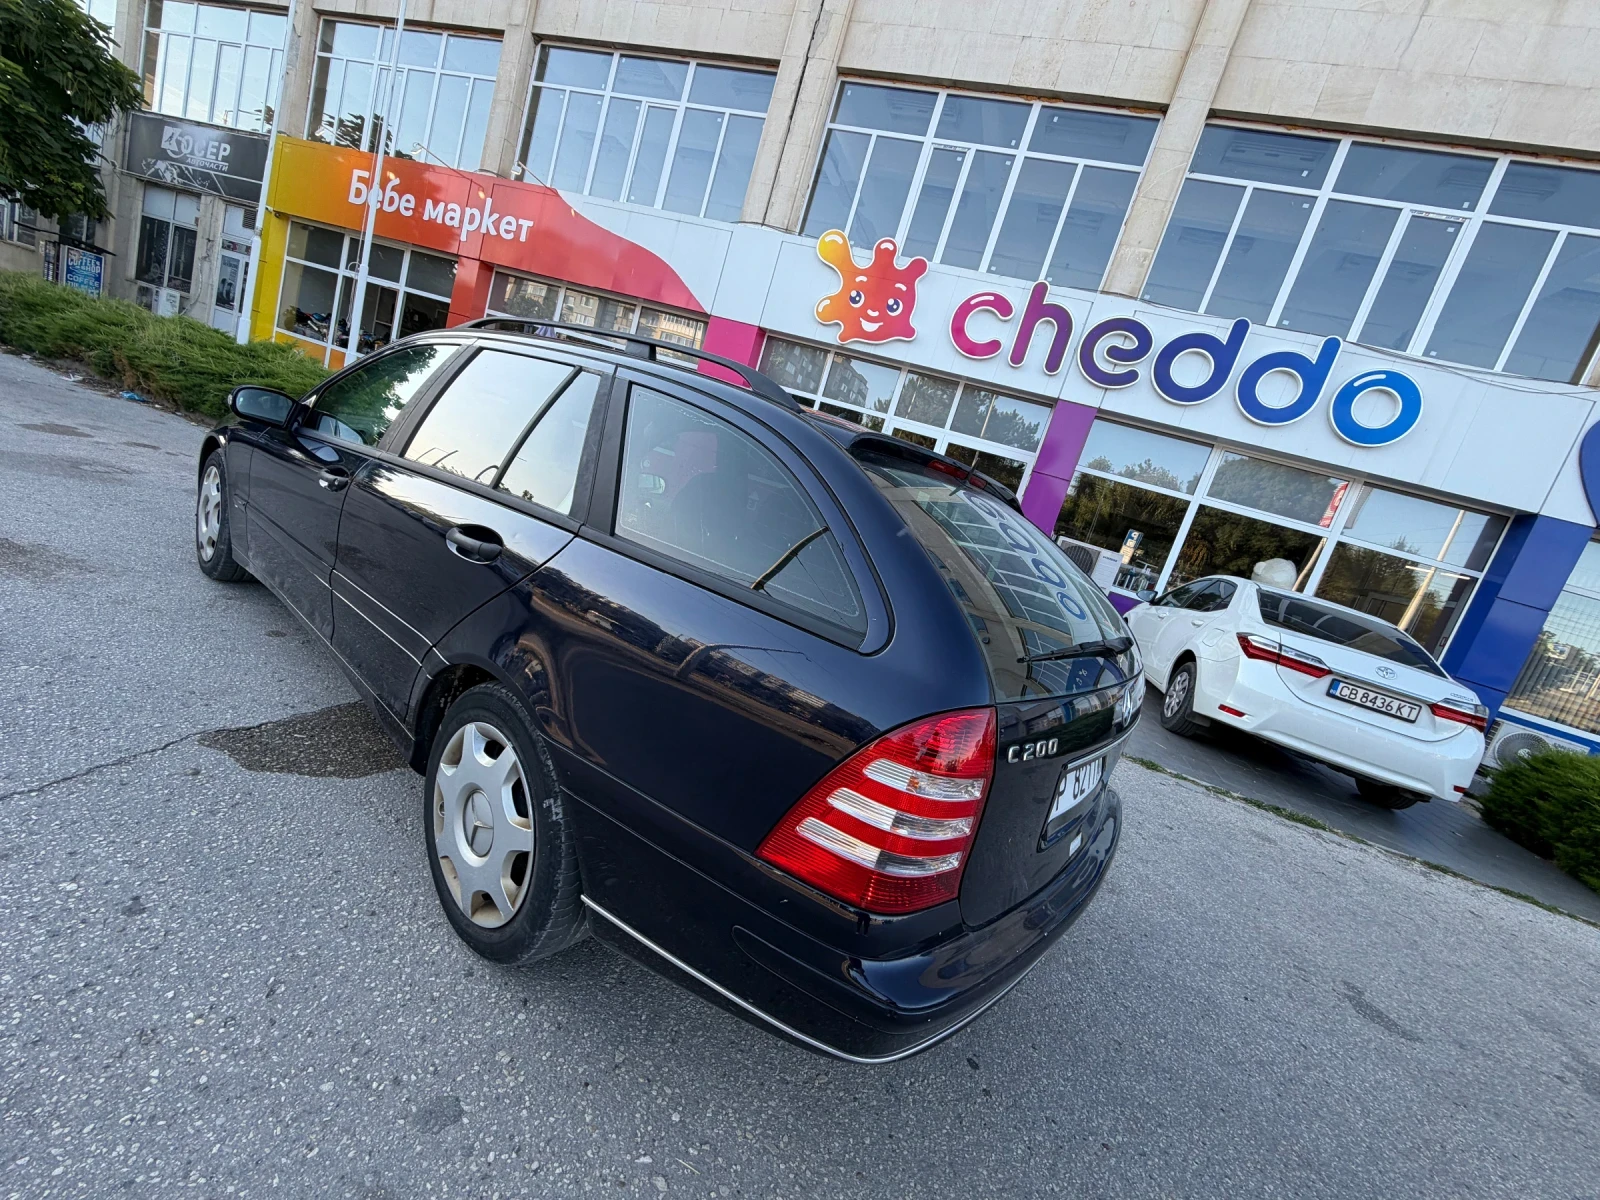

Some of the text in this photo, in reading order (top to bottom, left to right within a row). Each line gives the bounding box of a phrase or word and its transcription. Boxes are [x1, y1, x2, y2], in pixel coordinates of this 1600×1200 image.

[186, 158, 228, 172] АВТОЧАСТИ
[348, 169, 534, 242] Бебе маркет
[67, 273, 100, 288] COFFEE
[949, 279, 1424, 448] cheddo
[1339, 685, 1359, 700] CB
[1359, 692, 1394, 712] 8436
[1394, 702, 1417, 718] KT
